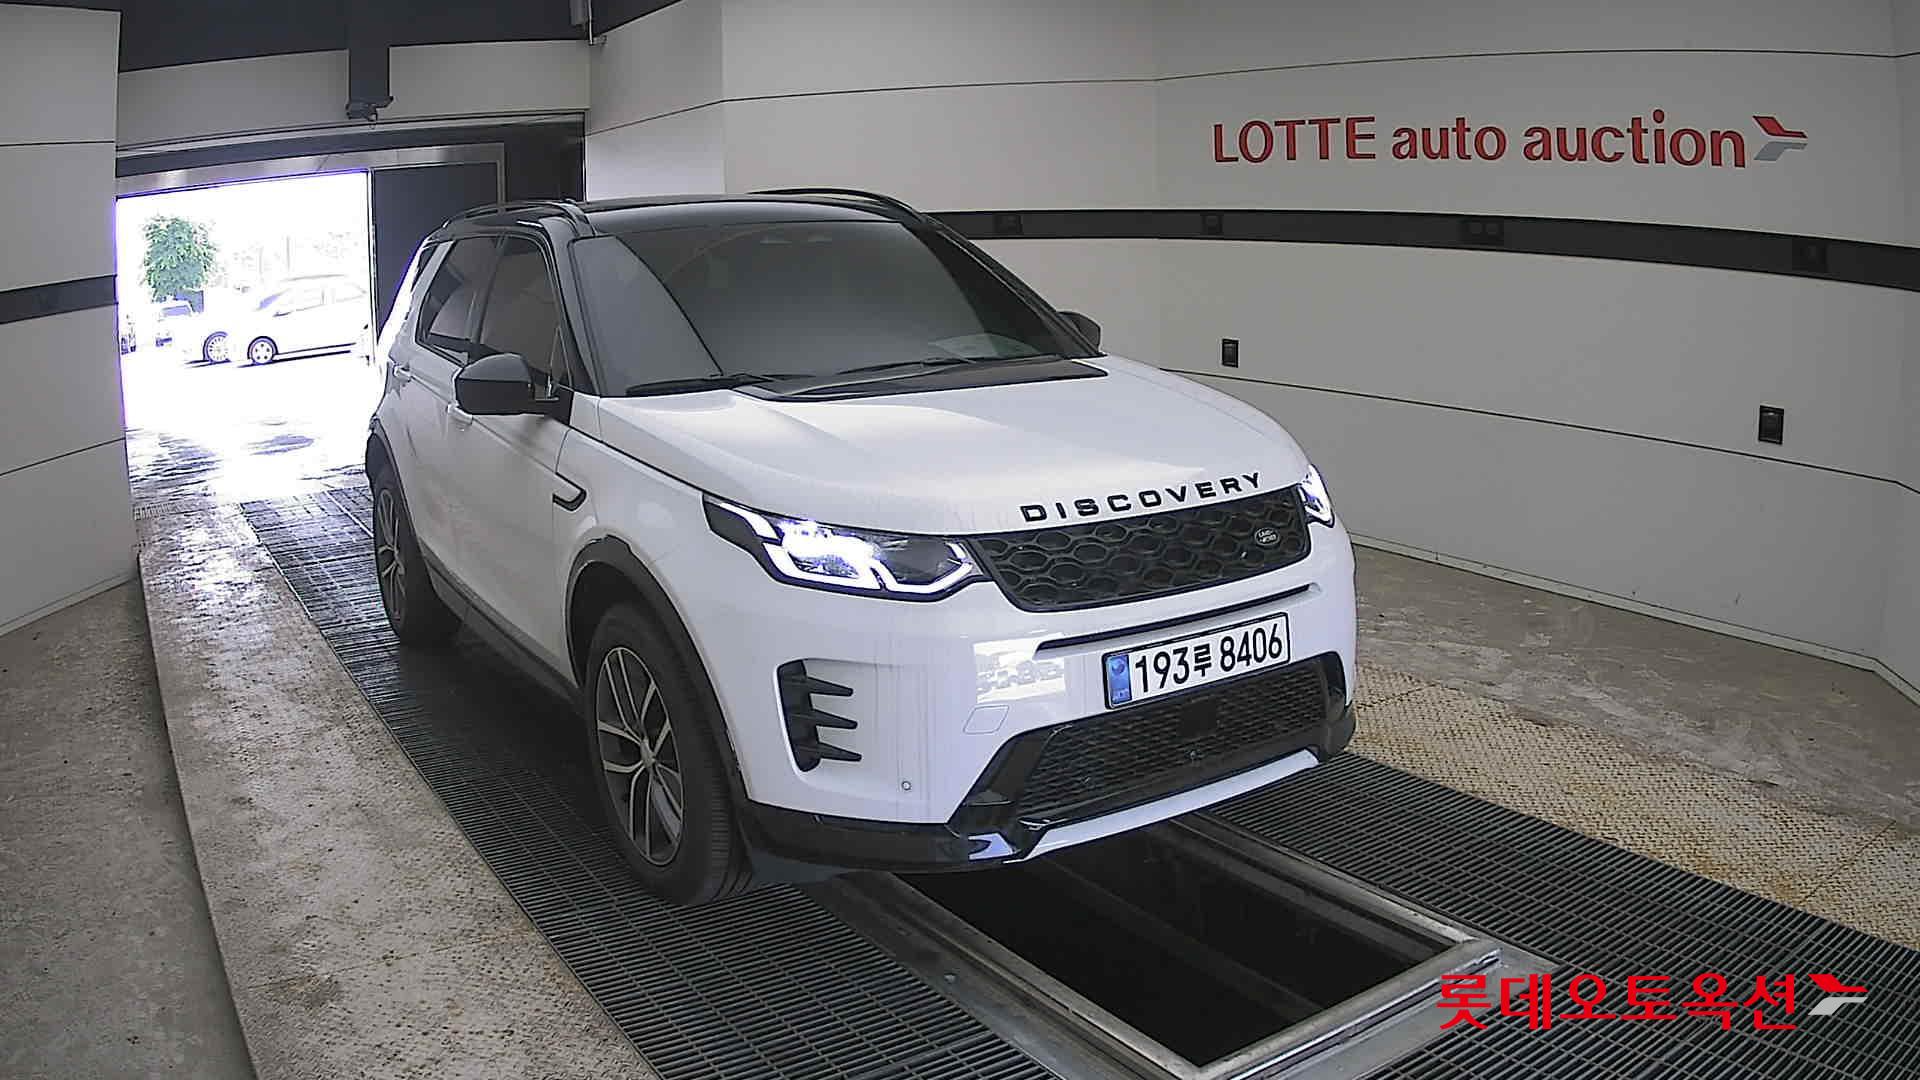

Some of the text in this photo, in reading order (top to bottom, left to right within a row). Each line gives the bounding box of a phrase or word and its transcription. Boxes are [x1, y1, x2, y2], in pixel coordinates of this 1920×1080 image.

[1213, 108, 1747, 168] LOTTE auto auction
[1020, 472, 1261, 522] DISCOVERY
[1220, 623, 1283, 672] 8406
